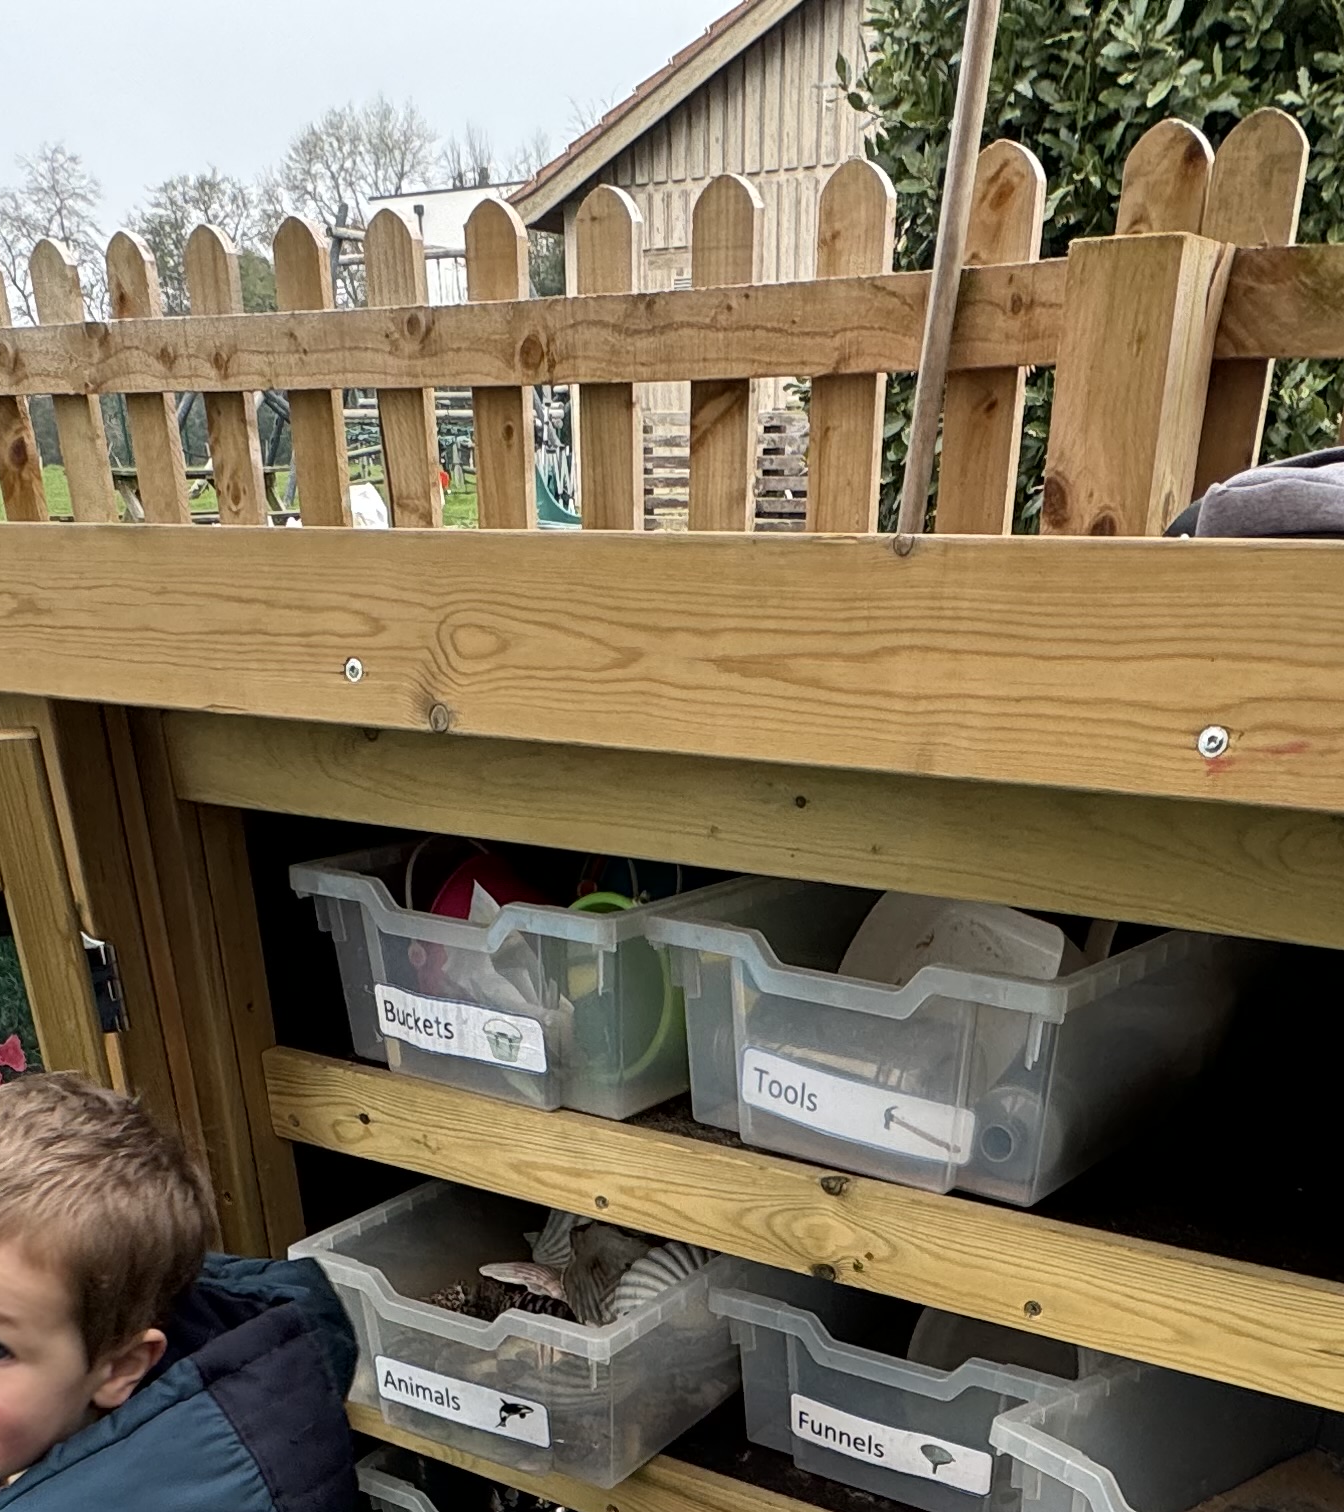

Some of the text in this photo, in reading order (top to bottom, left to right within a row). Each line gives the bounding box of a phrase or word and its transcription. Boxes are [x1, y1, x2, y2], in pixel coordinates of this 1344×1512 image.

[382, 999, 455, 1041] Buckets
[753, 1066, 819, 1113] Tools
[383, 1369, 461, 1411] Animals
[797, 1409, 885, 1459] Funnels
